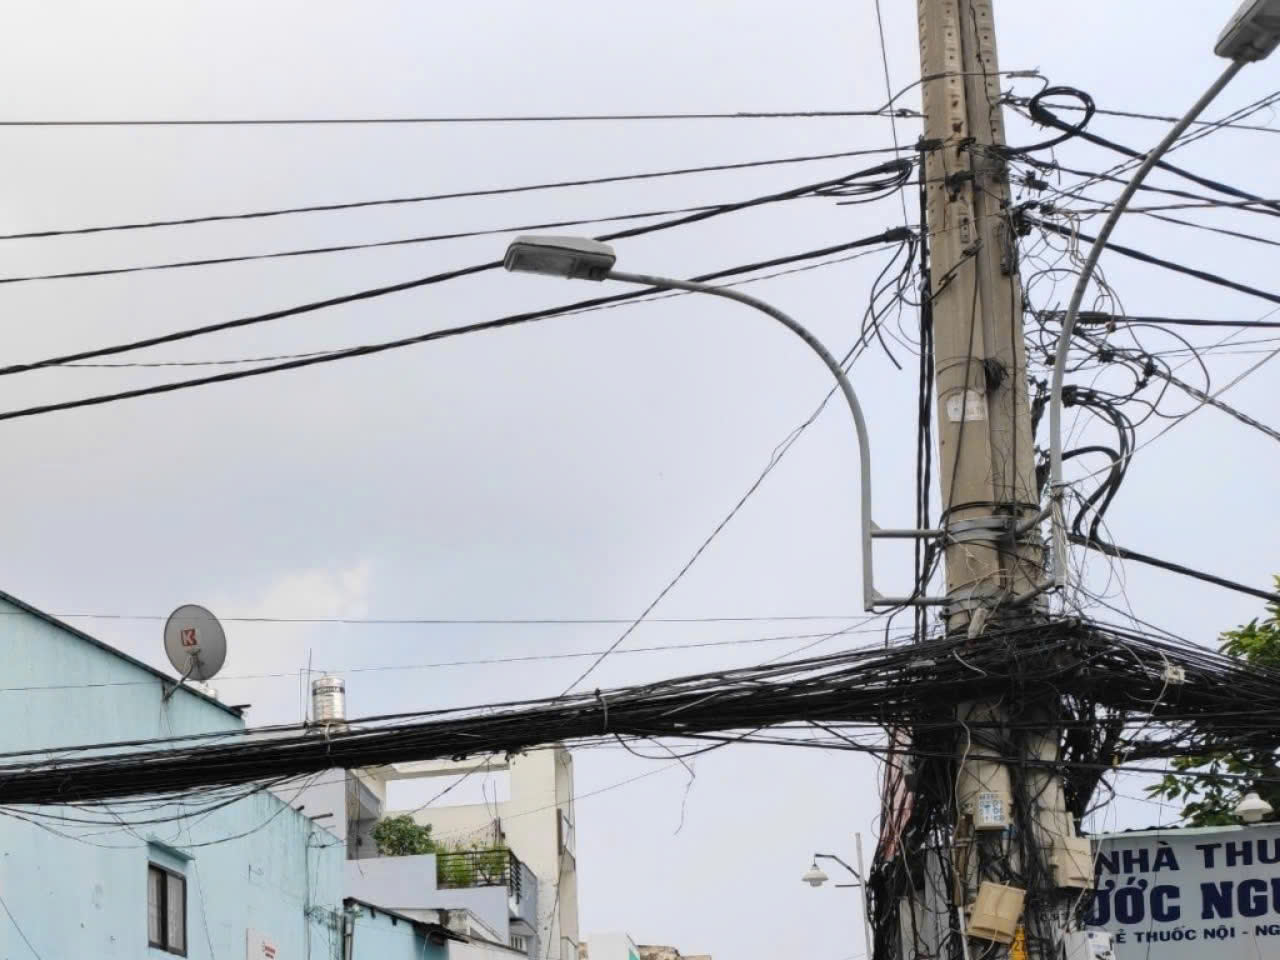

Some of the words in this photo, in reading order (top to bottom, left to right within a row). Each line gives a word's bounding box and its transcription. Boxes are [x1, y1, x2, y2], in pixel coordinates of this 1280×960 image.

[1095, 840, 1180, 876] NHÀ
[1133, 924, 1197, 944] THUỐC
[1203, 924, 1236, 941] NỘI
